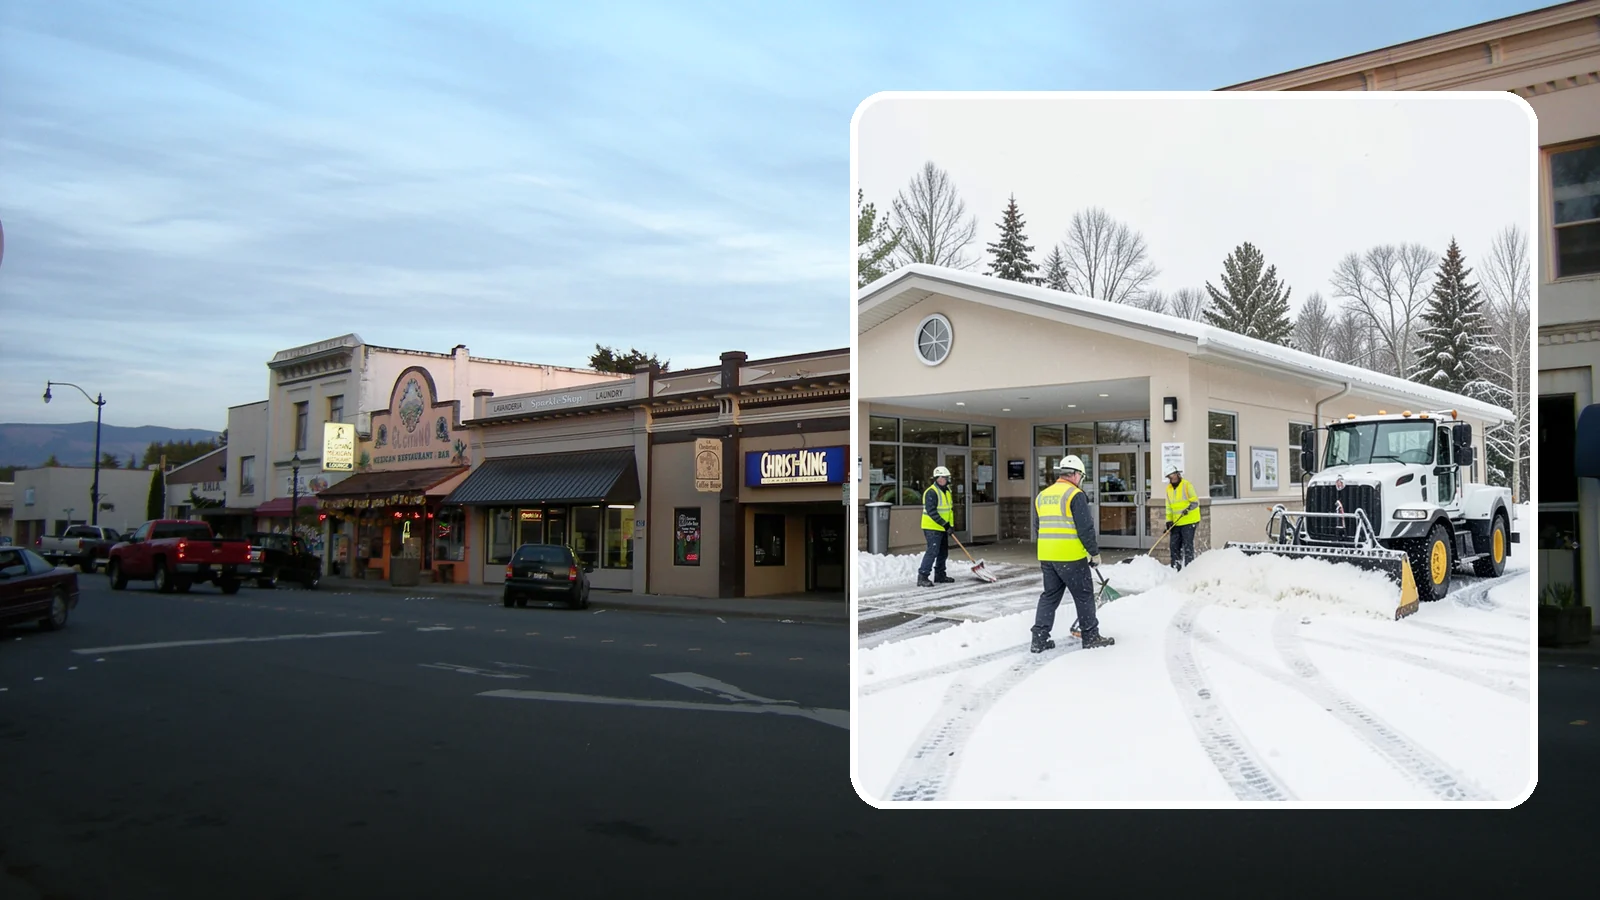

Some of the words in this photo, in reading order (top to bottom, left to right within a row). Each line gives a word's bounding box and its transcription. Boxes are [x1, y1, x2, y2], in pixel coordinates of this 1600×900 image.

[561, 395, 582, 405] Shop
[595, 389, 623, 400] LAUNDRY
[493, 402, 522, 412] LAVANDERIA
[373, 455, 396, 464] MEXICAN
[397, 452, 433, 462] RESTAURANT
[438, 450, 450, 459] BAR
[761, 452, 798, 478] CHRIST
[799, 450, 827, 476] KING
